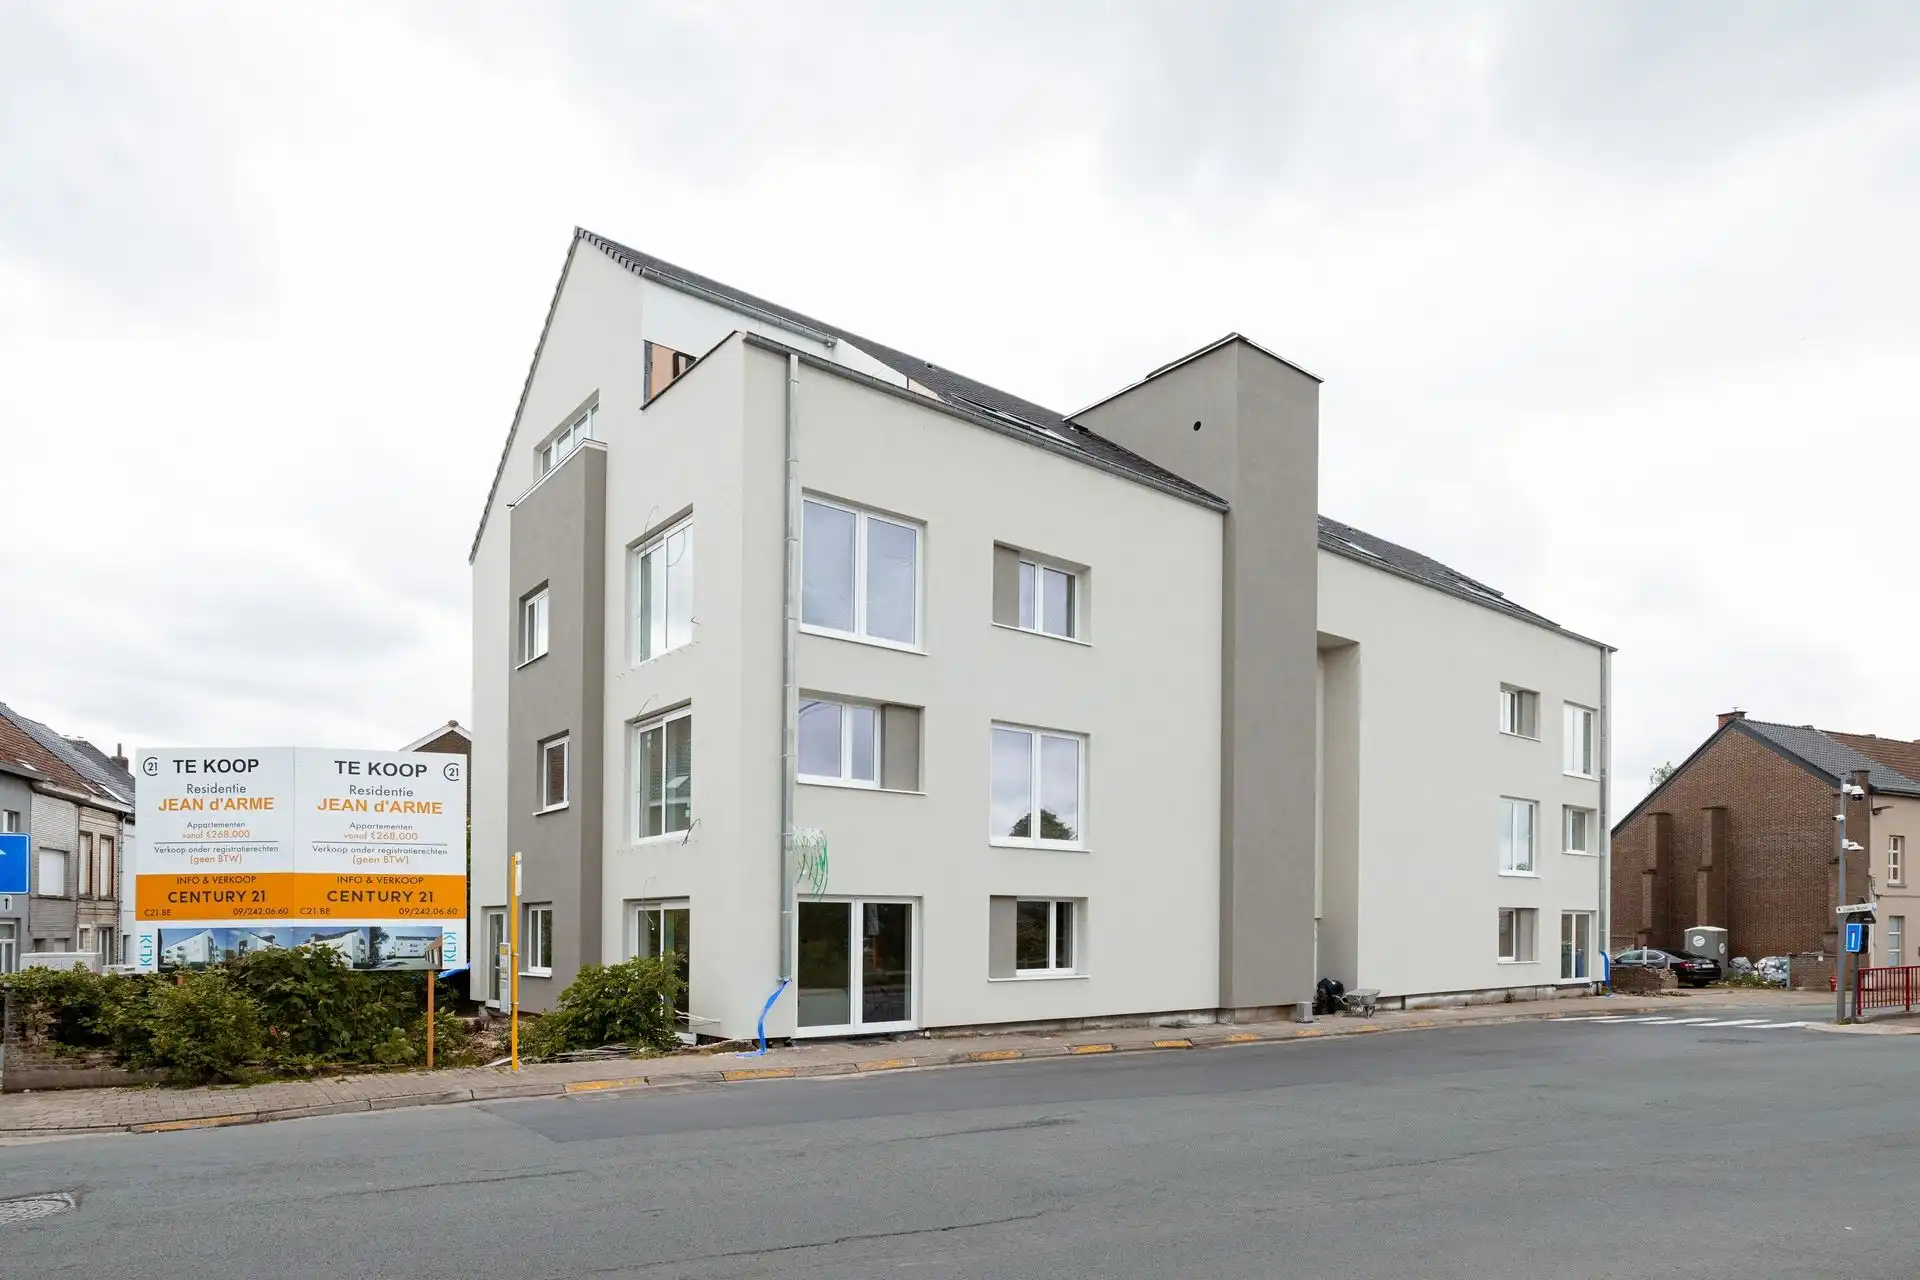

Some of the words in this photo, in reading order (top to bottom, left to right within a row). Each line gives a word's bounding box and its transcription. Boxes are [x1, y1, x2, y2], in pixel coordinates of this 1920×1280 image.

[173, 759, 197, 773] TE
[204, 759, 259, 773] KOOP
[335, 761, 360, 775] TE
[368, 762, 427, 777] KOOP
[186, 783, 246, 793] Residentie
[349, 785, 413, 797] Residentie
[158, 798, 203, 811] JEAN
[210, 797, 274, 810] d'ARME
[317, 798, 367, 812] JEAN
[374, 801, 443, 815] d'ARME
[187, 821, 246, 829] Appartementen
[350, 822, 413, 831] Appartementen
[154, 846, 186, 854] Verkoop
[213, 845, 279, 854] registratierechten
[312, 845, 348, 854] Verkoop
[378, 847, 448, 855] registratierechten
[190, 855, 215, 865] (geen
[218, 855, 242, 864] BTW)
[353, 855, 380, 865] (geen
[384, 855, 409, 865] BTW)
[177, 876, 199, 884] INFO
[203, 876, 209, 884] &
[212, 876, 256, 884] VERKOOP
[337, 876, 362, 884] INFO
[366, 876, 373, 884] &
[168, 891, 247, 903] CENTURY
[252, 890, 265, 902] 21
[327, 890, 413, 902] CENTURY
[420, 891, 433, 902] 21
[233, 908, 288, 916] 09/242.06.60
